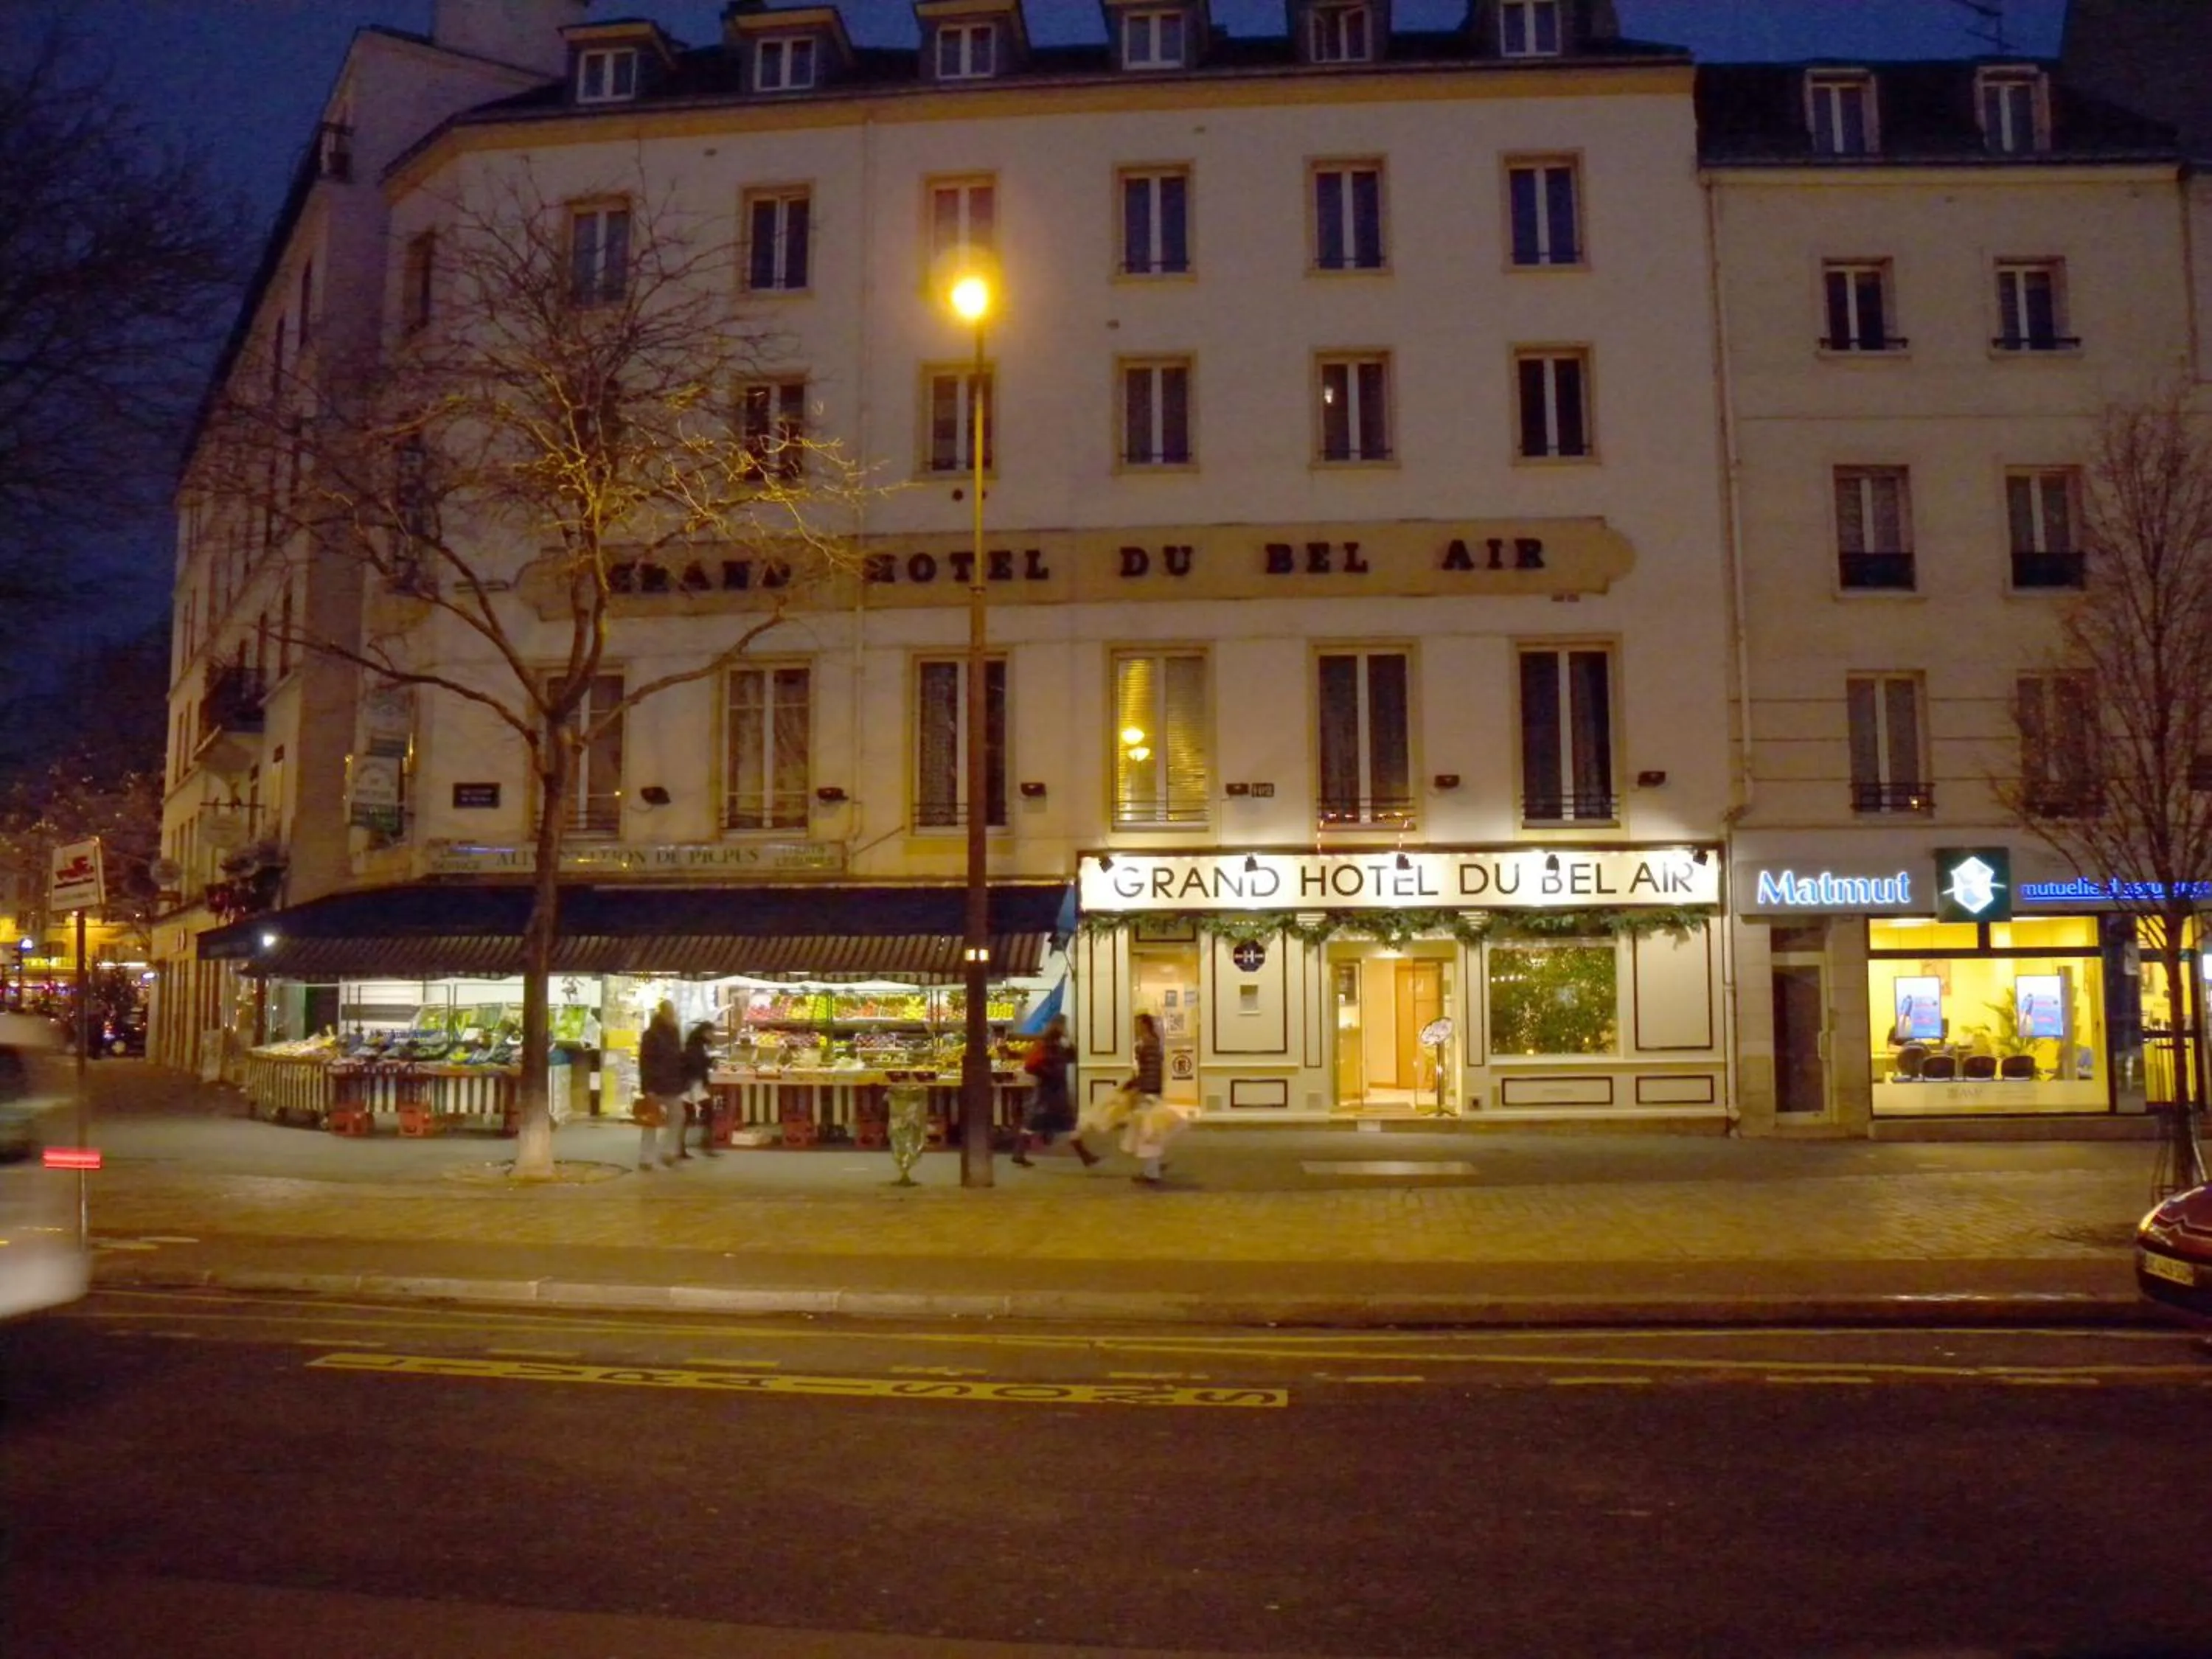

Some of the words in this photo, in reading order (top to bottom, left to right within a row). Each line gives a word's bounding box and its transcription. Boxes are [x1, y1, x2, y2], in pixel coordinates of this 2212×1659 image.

[608, 560, 791, 593] GRAND
[864, 549, 1048, 583] HOTEL
[1119, 546, 1194, 577] DU
[1265, 542, 1368, 574] BEL
[1441, 538, 1545, 571] AIR
[1113, 866, 1281, 897] GRAND
[1301, 864, 1439, 897] HOTEL
[1458, 863, 1520, 894] DU
[1542, 863, 1617, 894] BEL
[1629, 861, 1694, 894] AIR
[1757, 869, 1911, 905] Matmut
[2021, 877, 2100, 896] mutuelle
[322, 1357, 1279, 1405] LIVRAISONS
